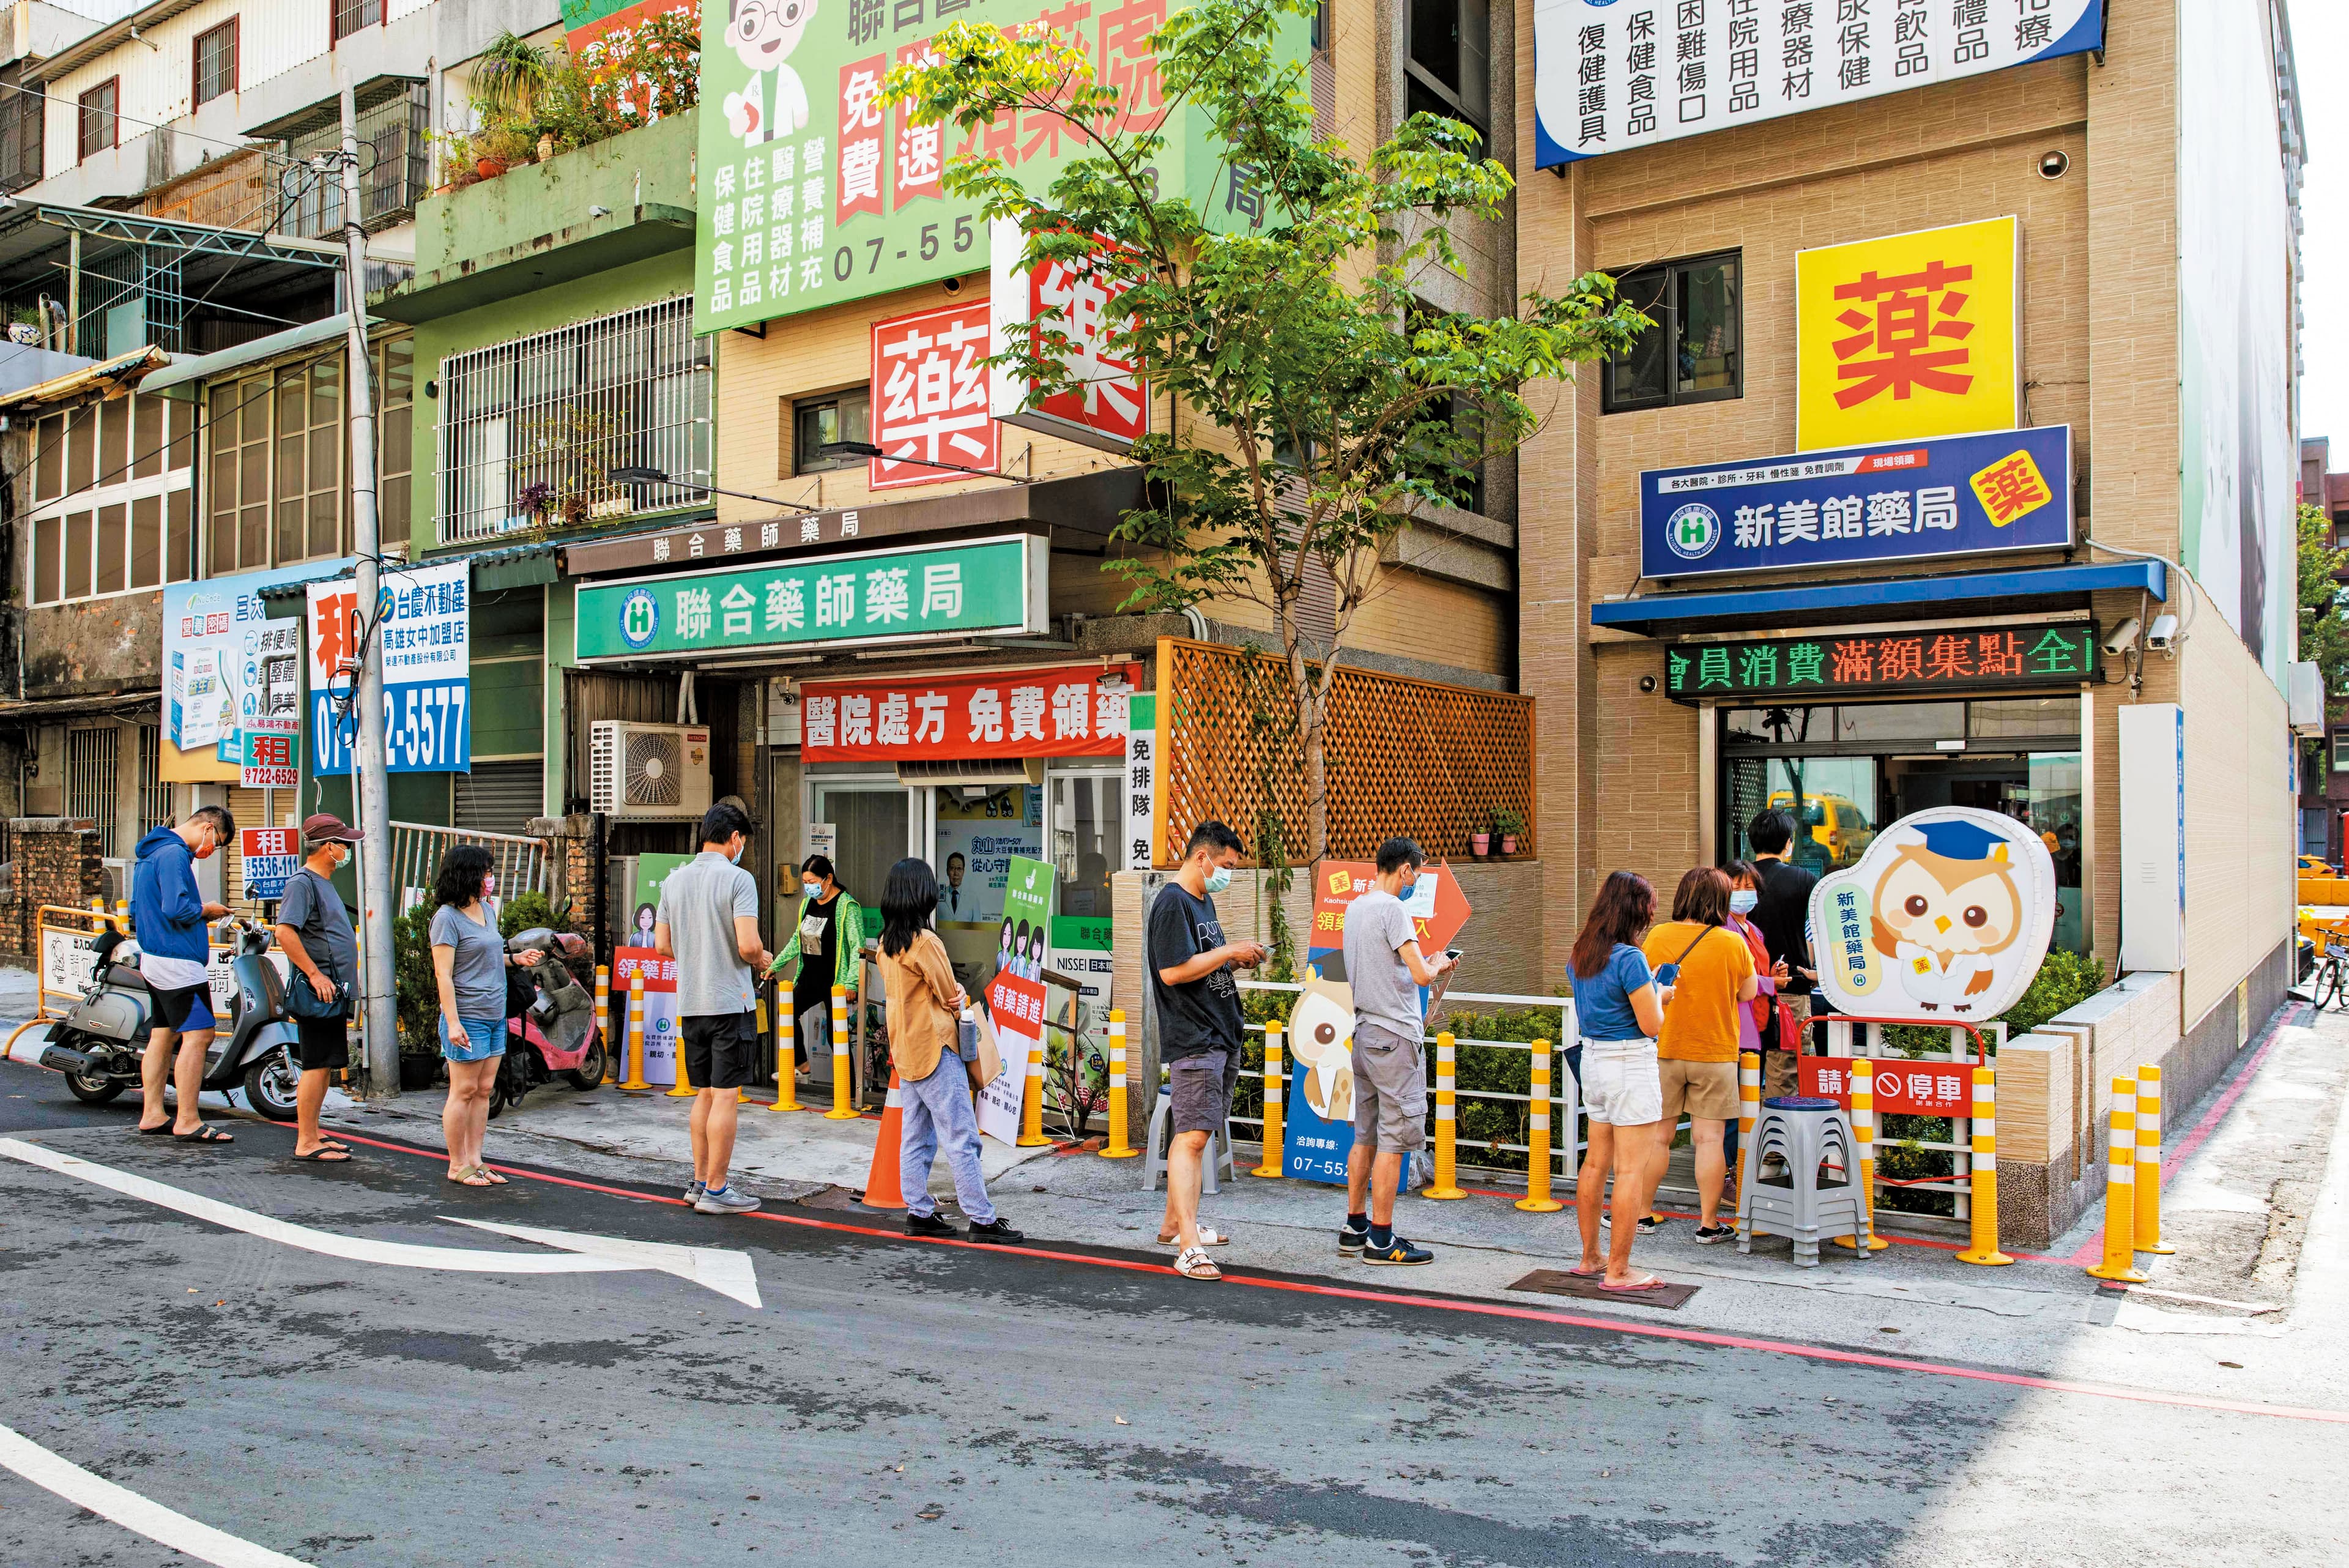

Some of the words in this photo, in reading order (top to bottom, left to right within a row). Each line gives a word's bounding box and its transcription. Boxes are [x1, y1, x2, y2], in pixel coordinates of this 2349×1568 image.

[1626, 10, 1656, 136] 保健食品
[1677, 0, 1707, 123] 困難傷口
[1781, 0, 1814, 100] 療器材
[1578, 23, 1607, 147] 復健護具
[710, 164, 736, 313] 保健食品
[739, 157, 765, 306] 住院用品
[769, 146, 796, 298] 醫療器材
[800, 137, 826, 292] 營養補充
[882, 319, 989, 471] 藥
[654, 511, 859, 562] 聯合藥師藥局
[1734, 486, 1958, 549] 新美館藥局
[182, 613, 229, 637] 營養密碼
[398, 579, 466, 620] 台慶不動產
[675, 562, 964, 641] 聯合藥師藥局
[384, 620, 464, 651] 高雄女中加盟店
[1671, 628, 2091, 690] 會員消費滿額集點全
[806, 690, 948, 748] 醫院處方
[251, 767, 297, 784] 722-6529
[252, 735, 291, 767] 租
[1132, 739, 1151, 816] 免排隊
[256, 831, 288, 855] 租
[971, 836, 995, 855] 丸山
[1132, 839, 1151, 870] 免
[1837, 891, 1866, 971] 新美館藥局
[1057, 957, 1087, 971] NISSEI
[993, 983, 1041, 1025] 領藥請進
[1817, 1068, 1852, 1096] 請
[1907, 1073, 1962, 1101] 停車
